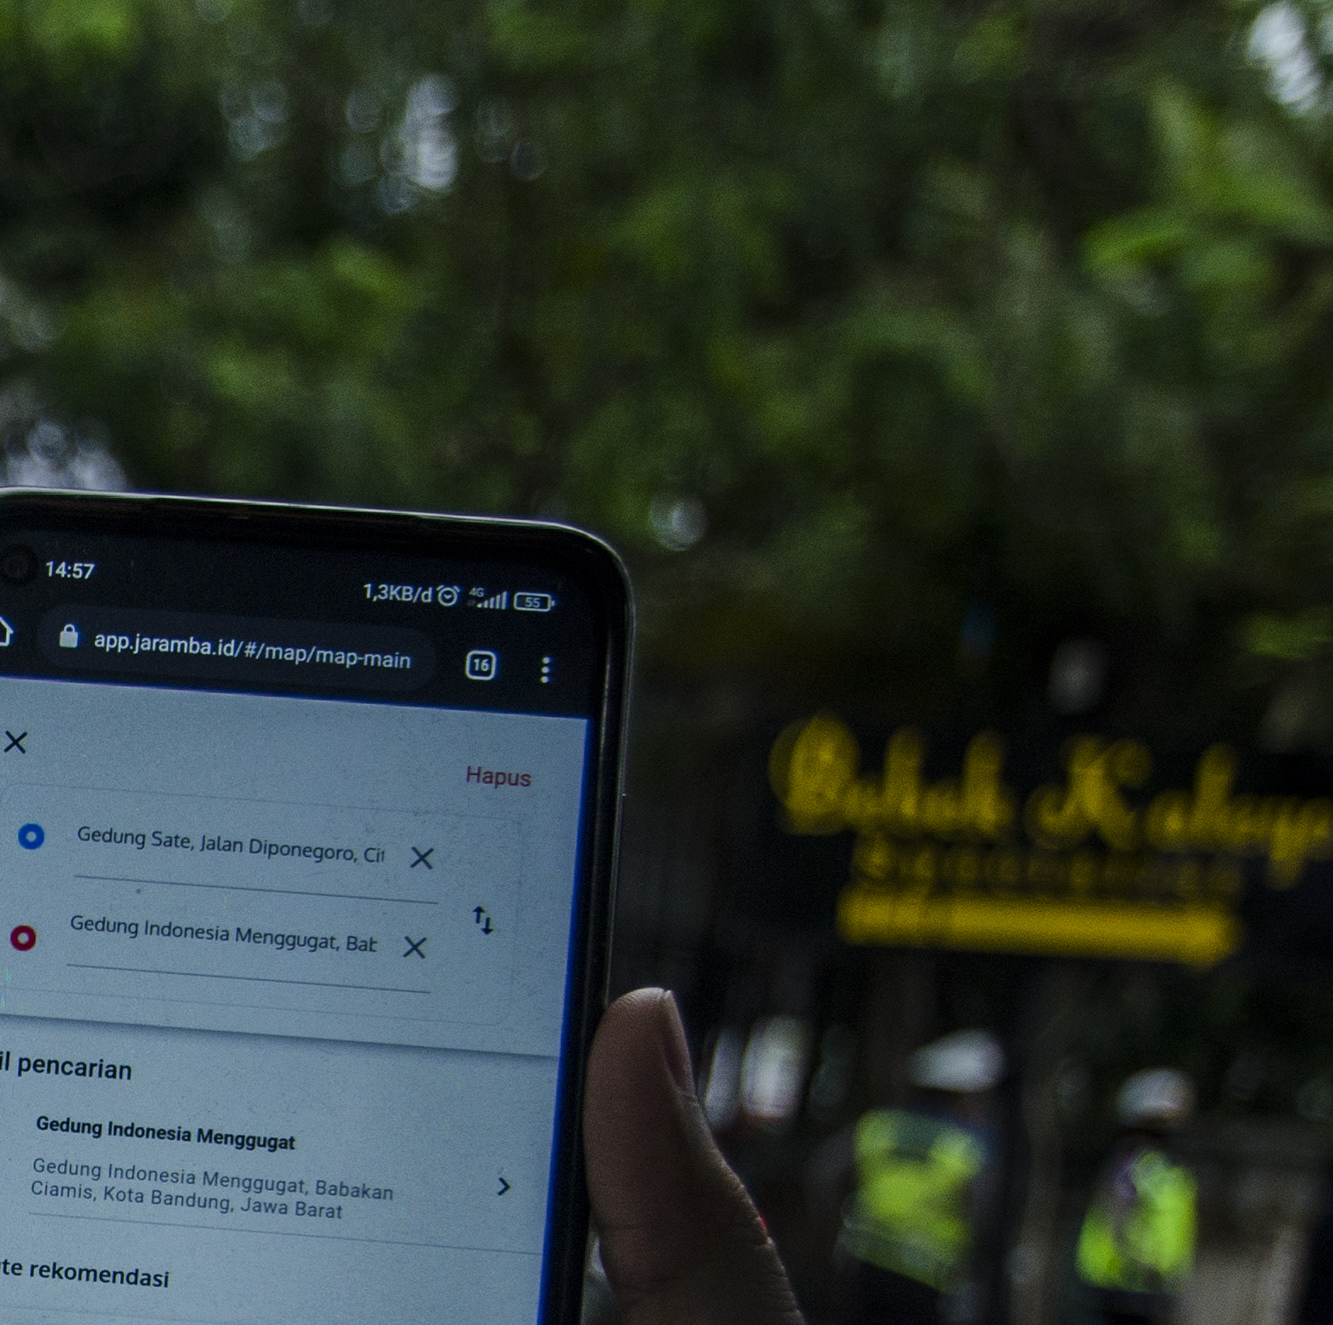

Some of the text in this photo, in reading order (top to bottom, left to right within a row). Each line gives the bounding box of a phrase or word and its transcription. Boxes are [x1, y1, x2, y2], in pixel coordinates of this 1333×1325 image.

[45, 560, 94, 580] 14:57
[363, 583, 432, 604] 1,3KB/d
[524, 597, 540, 608] 55
[94, 632, 411, 671] app.jaramba.id/#/map/map-main
[473, 657, 490, 672] 16
[466, 766, 532, 788] Hapus
[78, 826, 145, 850] Gedung
[151, 831, 195, 852] Sate,
[200, 834, 243, 853] Jalan
[249, 837, 359, 865] Diponegoro,
[71, 915, 139, 938] Gedung
[144, 920, 230, 942] Indonesia
[235, 926, 341, 953] Menggugat,
[18, 1053, 132, 1080] pencarian
[36, 1116, 295, 1152] Gedung Indonesia Menggugat
[34, 1157, 393, 1200] Gedung Indonesia Menggugat, Babakan
[31, 1179, 343, 1220] Ciamis, Kota Bandung, Jawa Barat
[30, 1261, 169, 1289] rekomendasi
